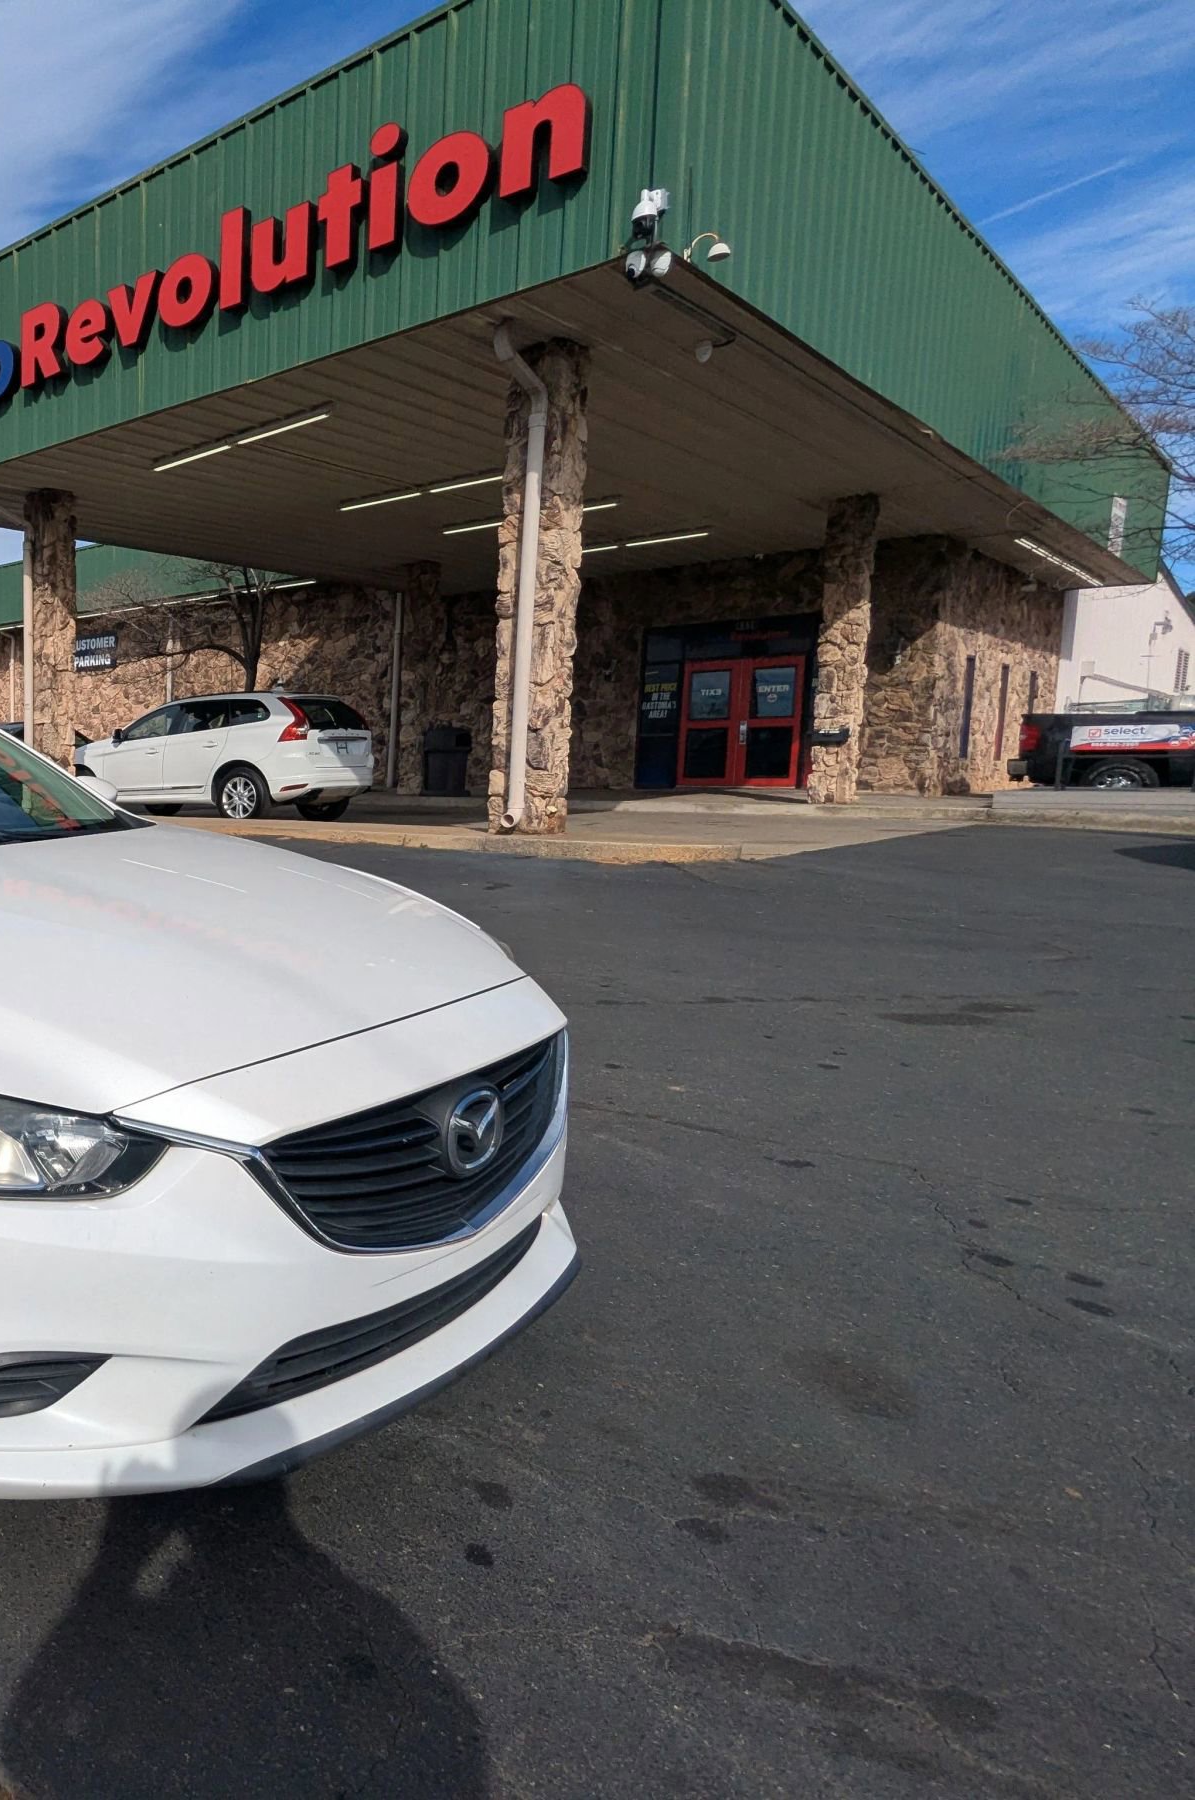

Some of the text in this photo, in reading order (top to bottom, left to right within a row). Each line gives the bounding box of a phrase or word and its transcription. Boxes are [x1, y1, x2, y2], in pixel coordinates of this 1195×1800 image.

[75, 636, 116, 651] USTOMER
[74, 653, 111, 668] PARKING
[757, 684, 790, 693] ENTER
[1103, 727, 1146, 736] select
